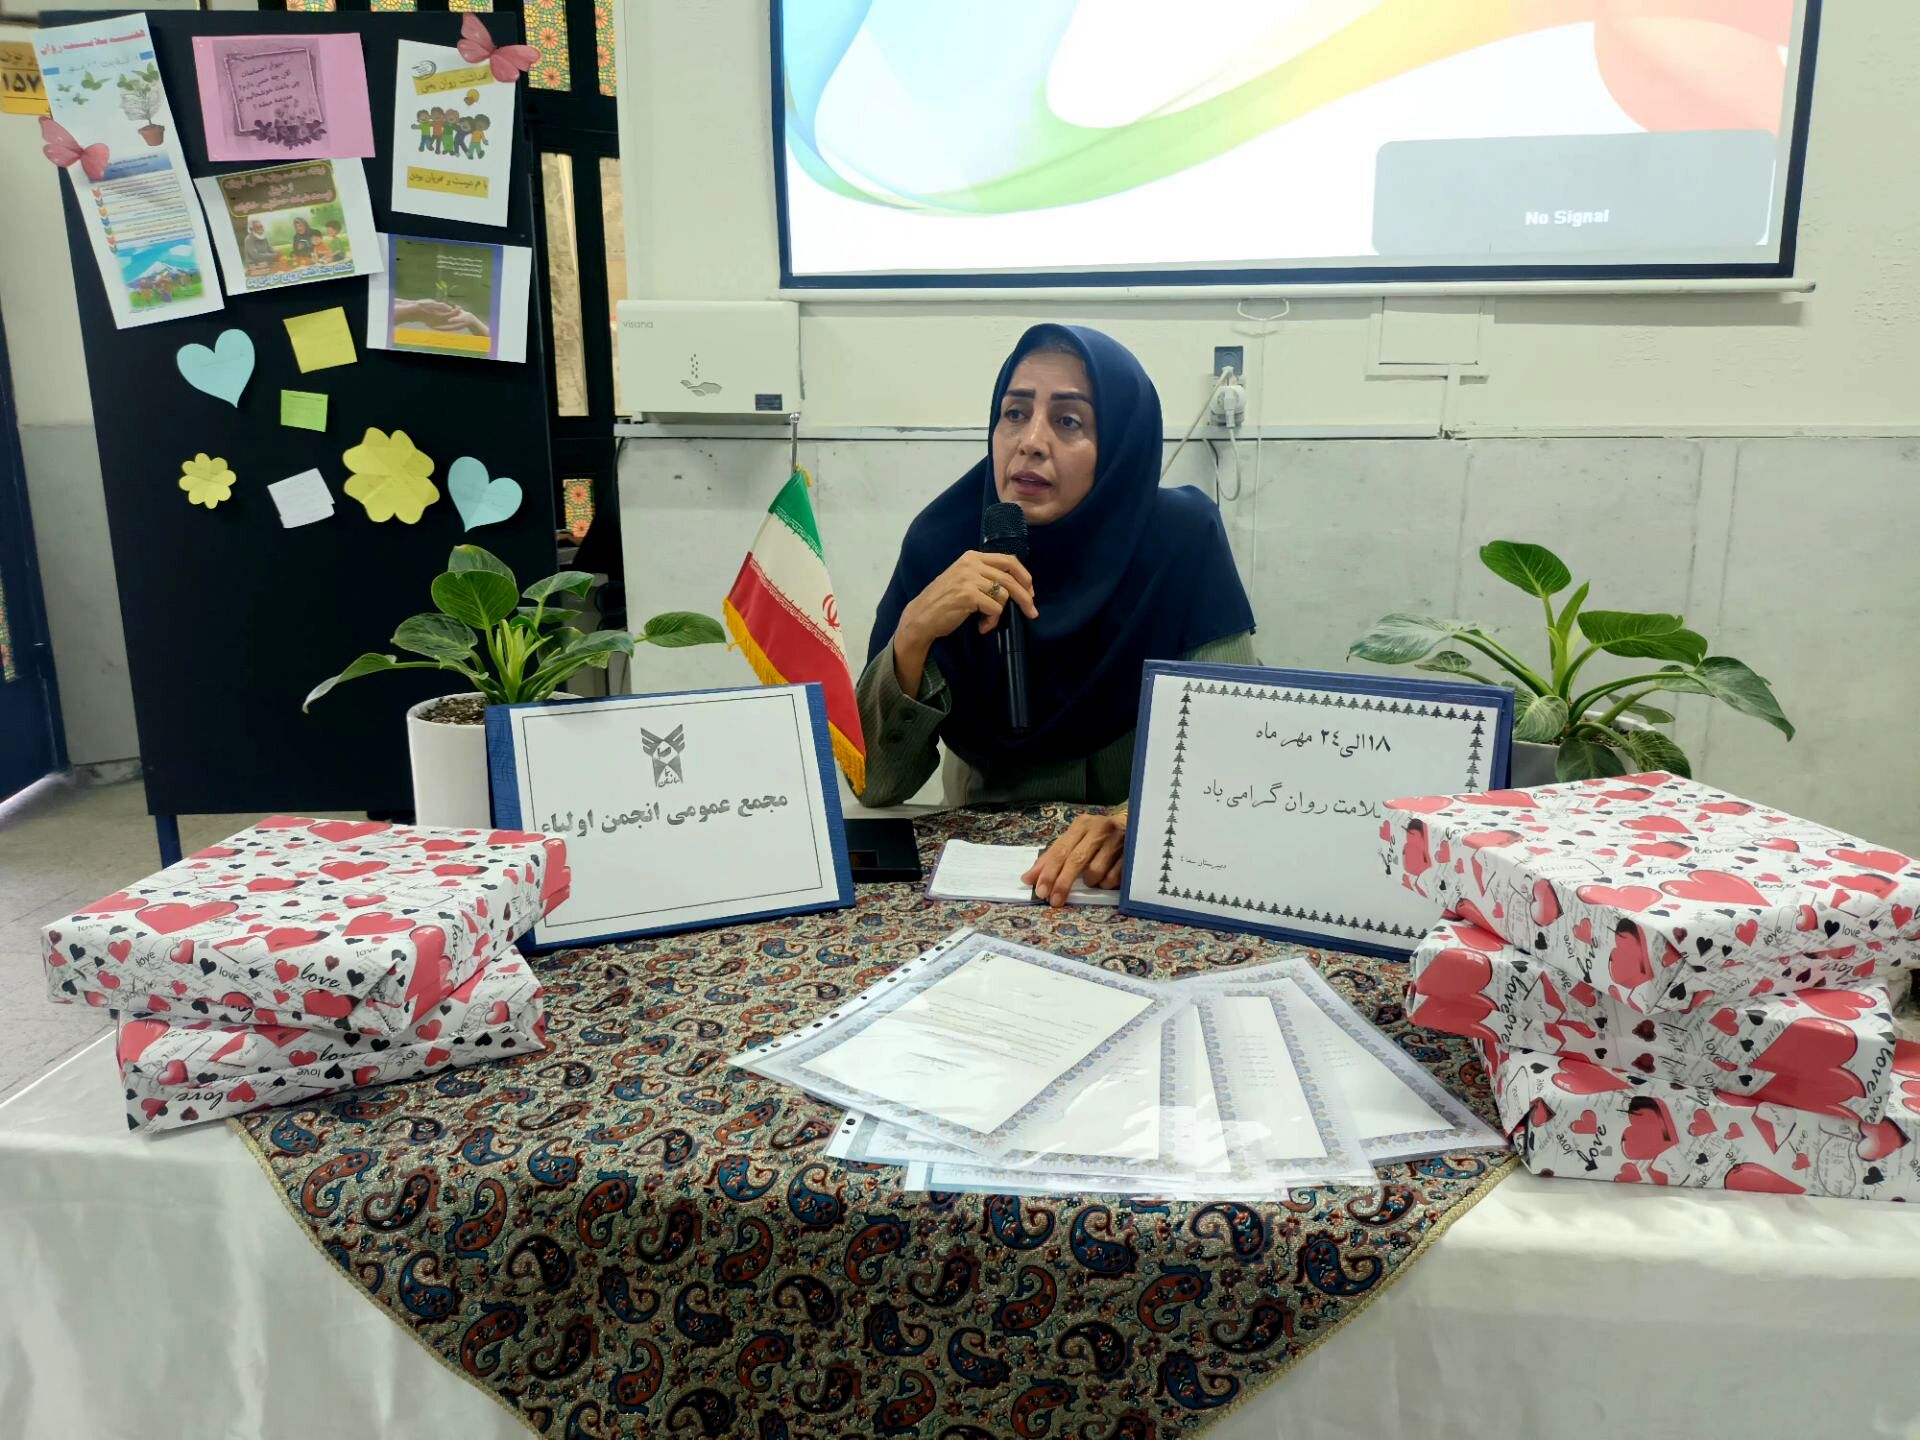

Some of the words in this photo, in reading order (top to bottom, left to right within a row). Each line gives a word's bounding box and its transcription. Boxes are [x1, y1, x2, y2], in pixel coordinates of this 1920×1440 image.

[1525, 210, 1549, 226] No
[1553, 208, 1610, 228] Signal
[1256, 721, 1278, 740] ماه
[1280, 731, 1312, 748] مهر
[1203, 778, 1224, 802] باد
[1226, 781, 1283, 809] گرامی
[667, 799, 730, 825] عمومی
[737, 794, 788, 818] مجمع
[1284, 791, 1328, 815] روان
[1332, 799, 1381, 819] لامت
[601, 801, 660, 834] انجمن
[1763, 926, 1783, 945] love
[1842, 925, 1861, 938] love
[1563, 933, 1576, 960] love
[135, 950, 156, 967] love
[219, 966, 240, 981] love
[300, 962, 341, 988] love
[1501, 1013, 1518, 1044] ove
[296, 1065, 322, 1078] love
[1866, 1047, 1894, 1094] love
[176, 1090, 224, 1111] love
[1864, 1095, 1884, 1122] ove
[1555, 1132, 1574, 1155] love
